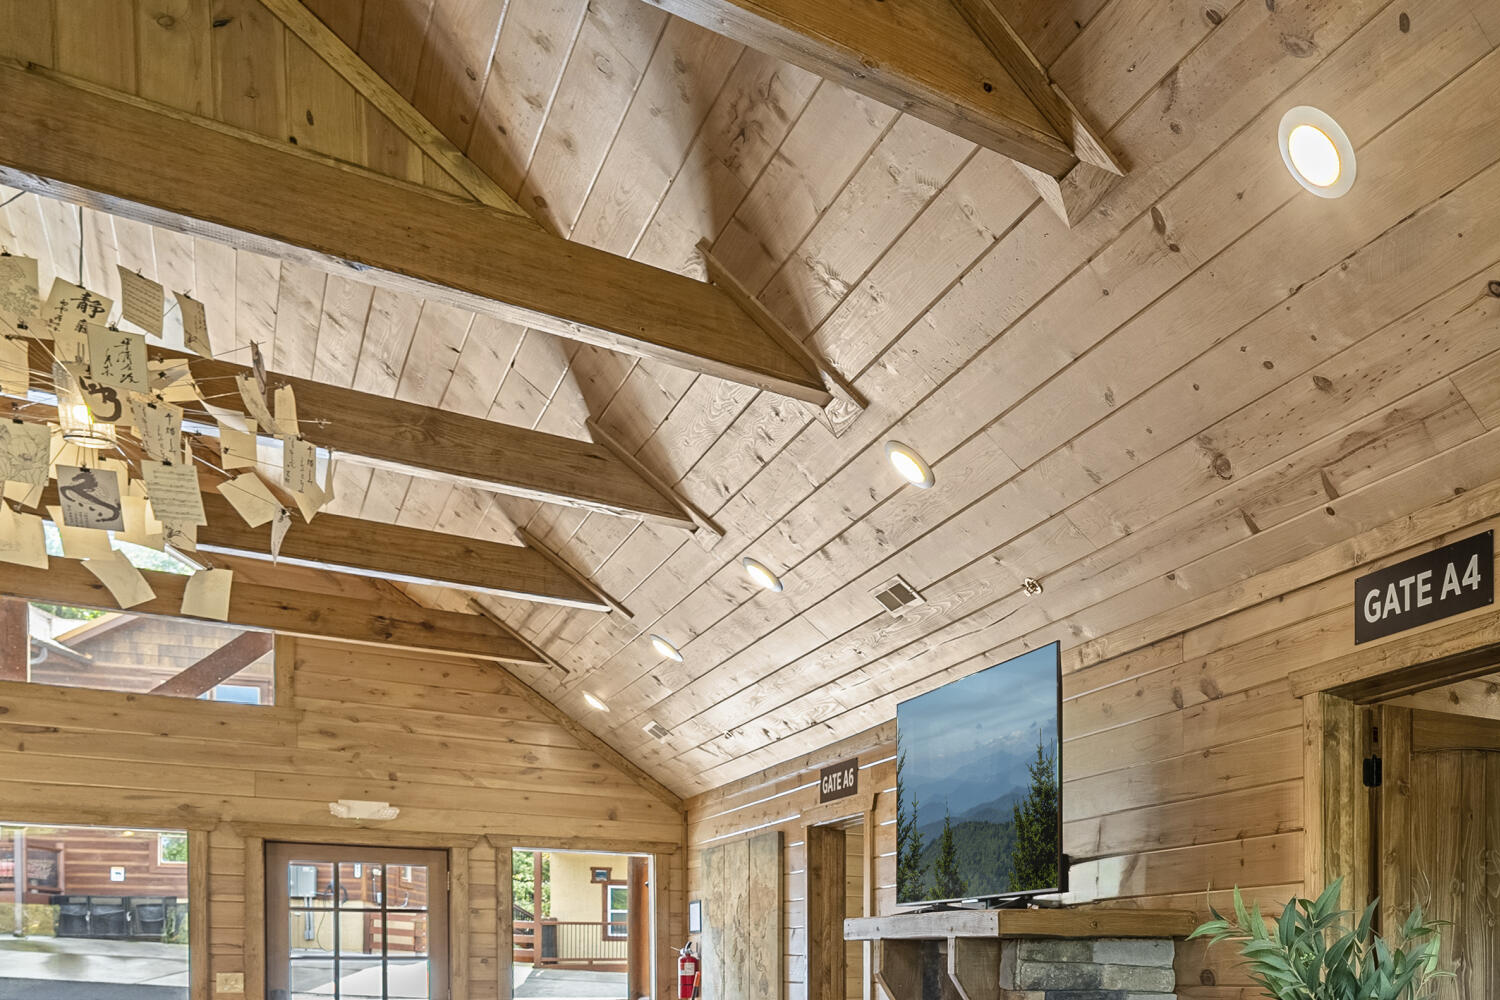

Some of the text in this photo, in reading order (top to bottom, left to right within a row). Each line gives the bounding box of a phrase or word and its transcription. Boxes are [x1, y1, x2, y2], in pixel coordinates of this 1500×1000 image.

[1364, 553, 1481, 624] GATE A4
[823, 768, 854, 794] GATE A6
